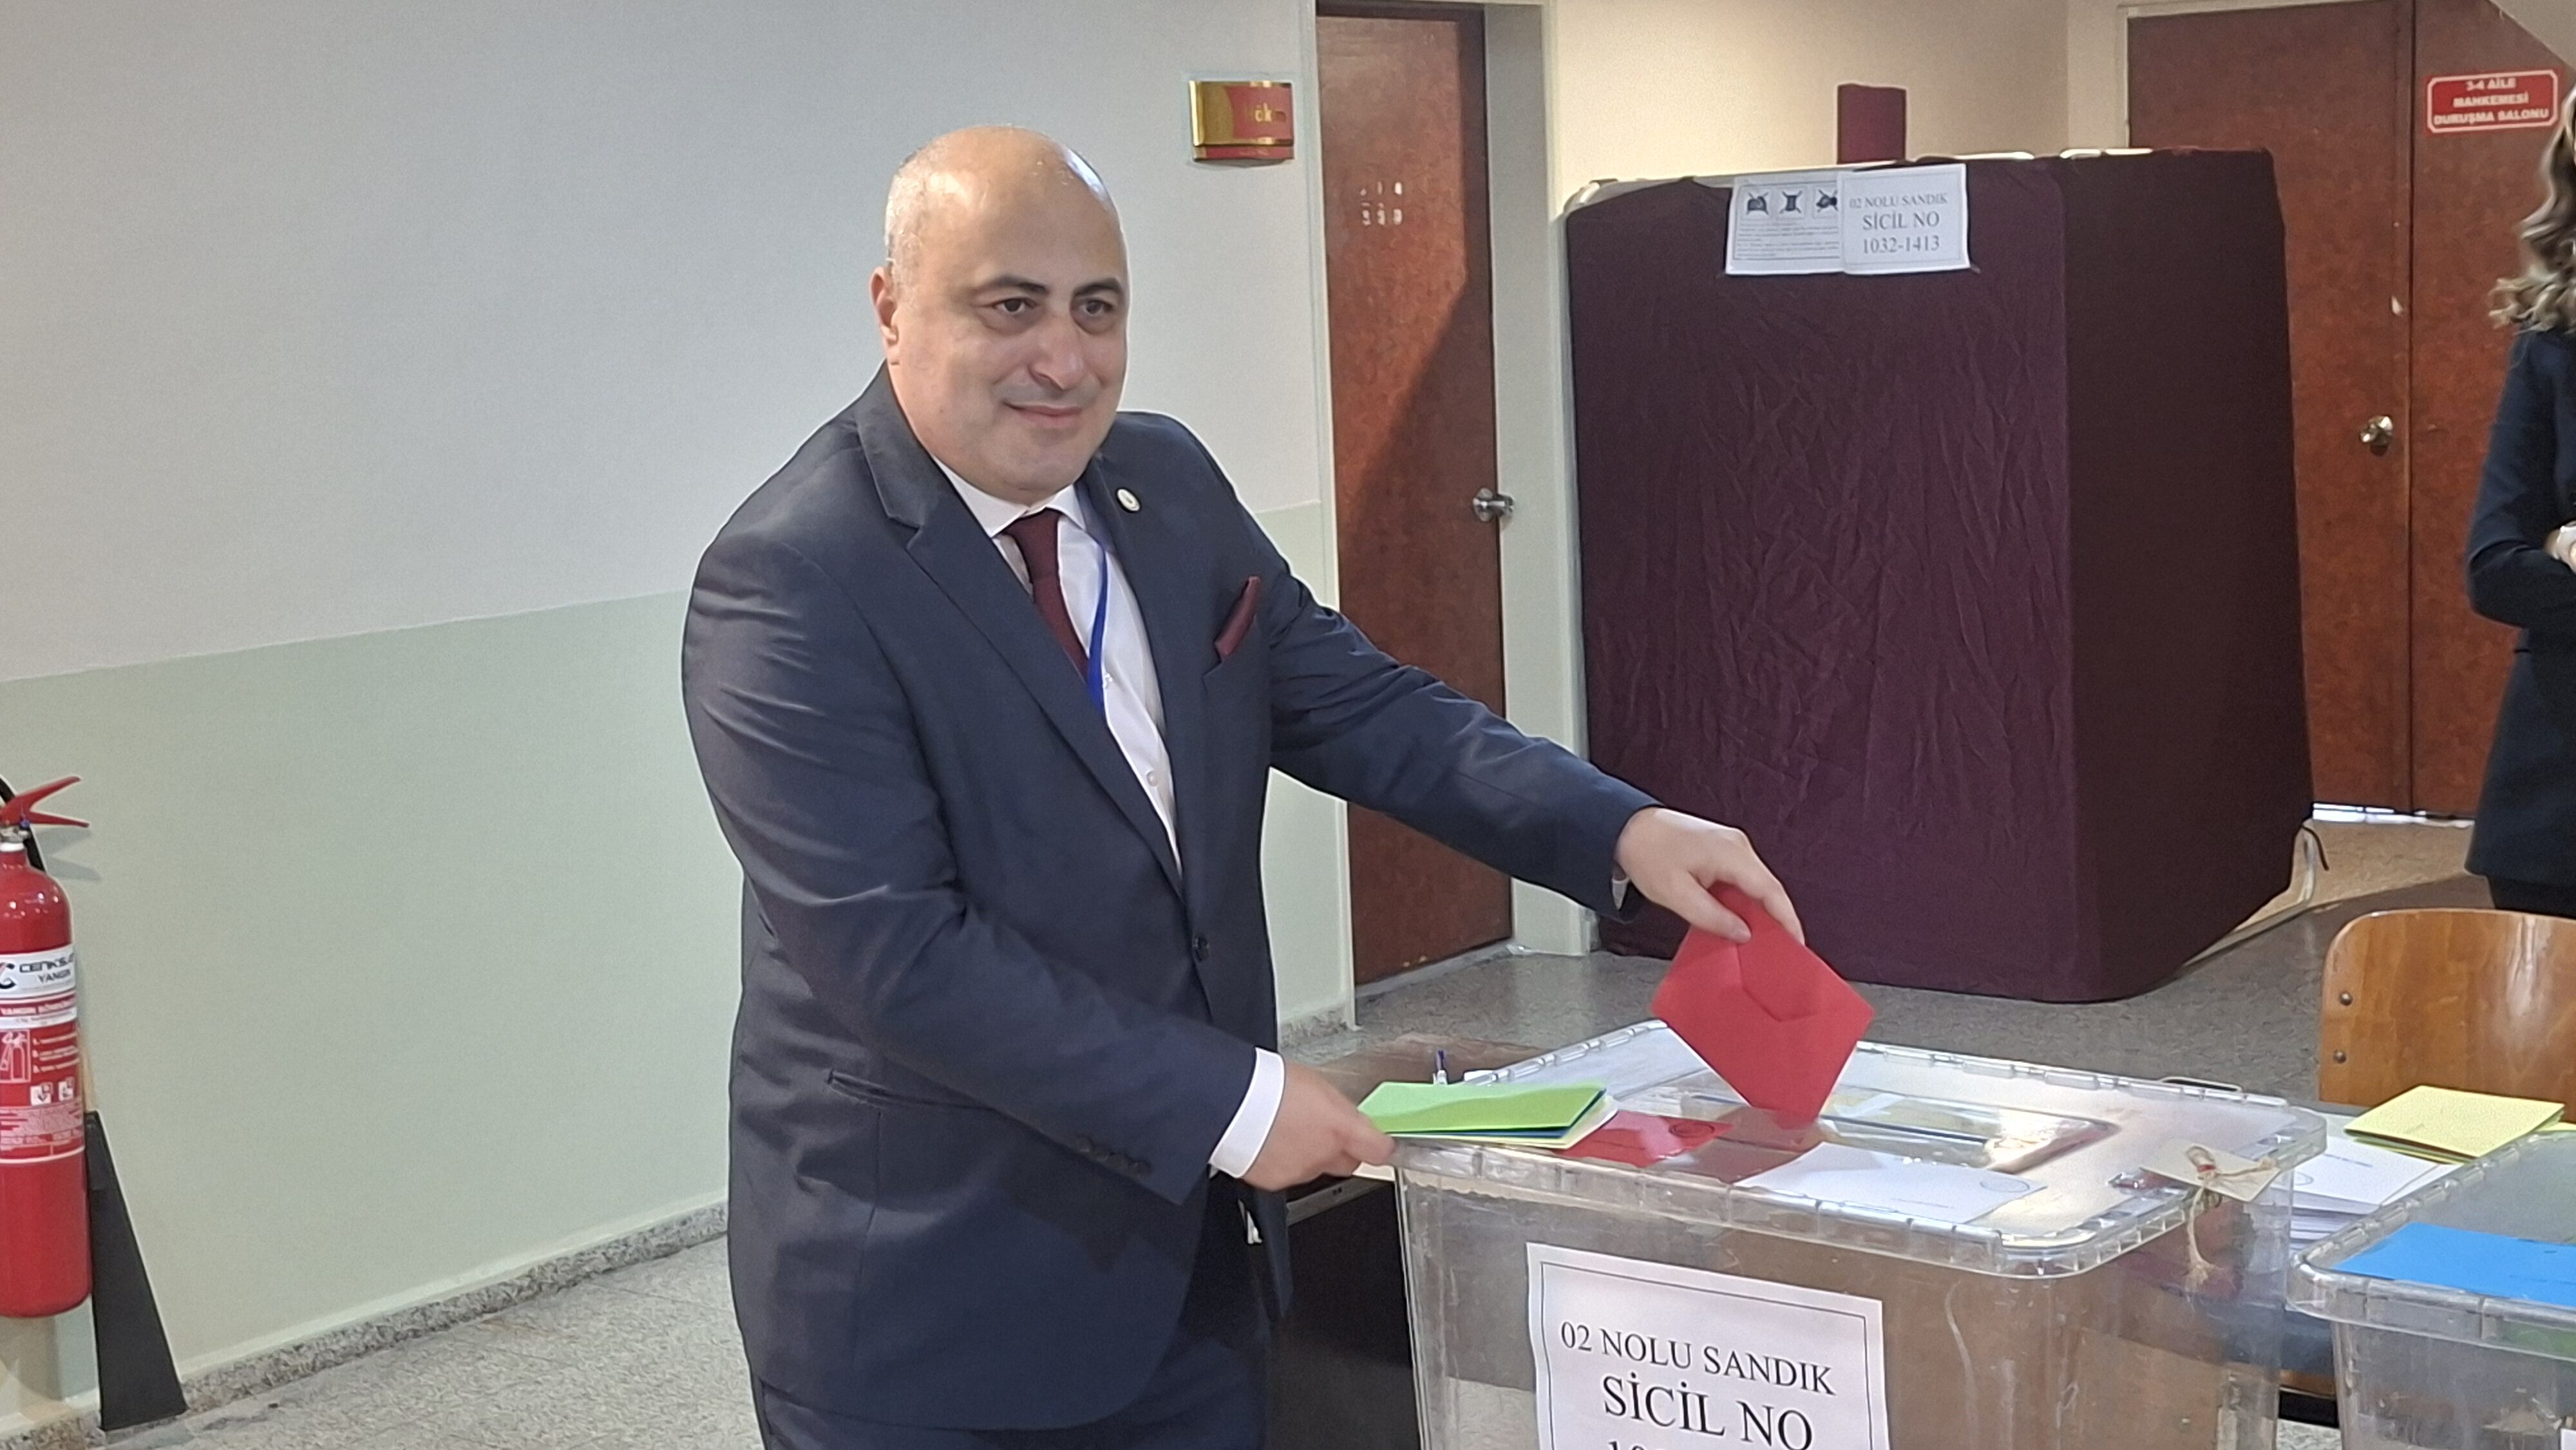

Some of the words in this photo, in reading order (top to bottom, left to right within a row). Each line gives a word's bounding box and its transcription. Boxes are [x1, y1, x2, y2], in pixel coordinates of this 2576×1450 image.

[2487, 77, 2516, 89] AİLE
[2453, 91, 2529, 108] MAHKEMESİ
[2434, 111, 2495, 125] DURUŞMA
[2497, 108, 2550, 121] SALONU
[1850, 198, 1862, 209] 02
[1865, 196, 1899, 207] NOLU
[1902, 193, 1948, 205] SANDIK
[1862, 211, 1907, 230] SİCİL
[1913, 211, 1940, 228] NO
[1864, 234, 1940, 254] 1032-1413
[1560, 1321, 1593, 1351] 02
[1598, 1328, 1692, 1369] NOLU
[1703, 1346, 1837, 1396] SANDIK
[1602, 1371, 1726, 1436] SİCİL
[1736, 1400, 1813, 1450] NO
